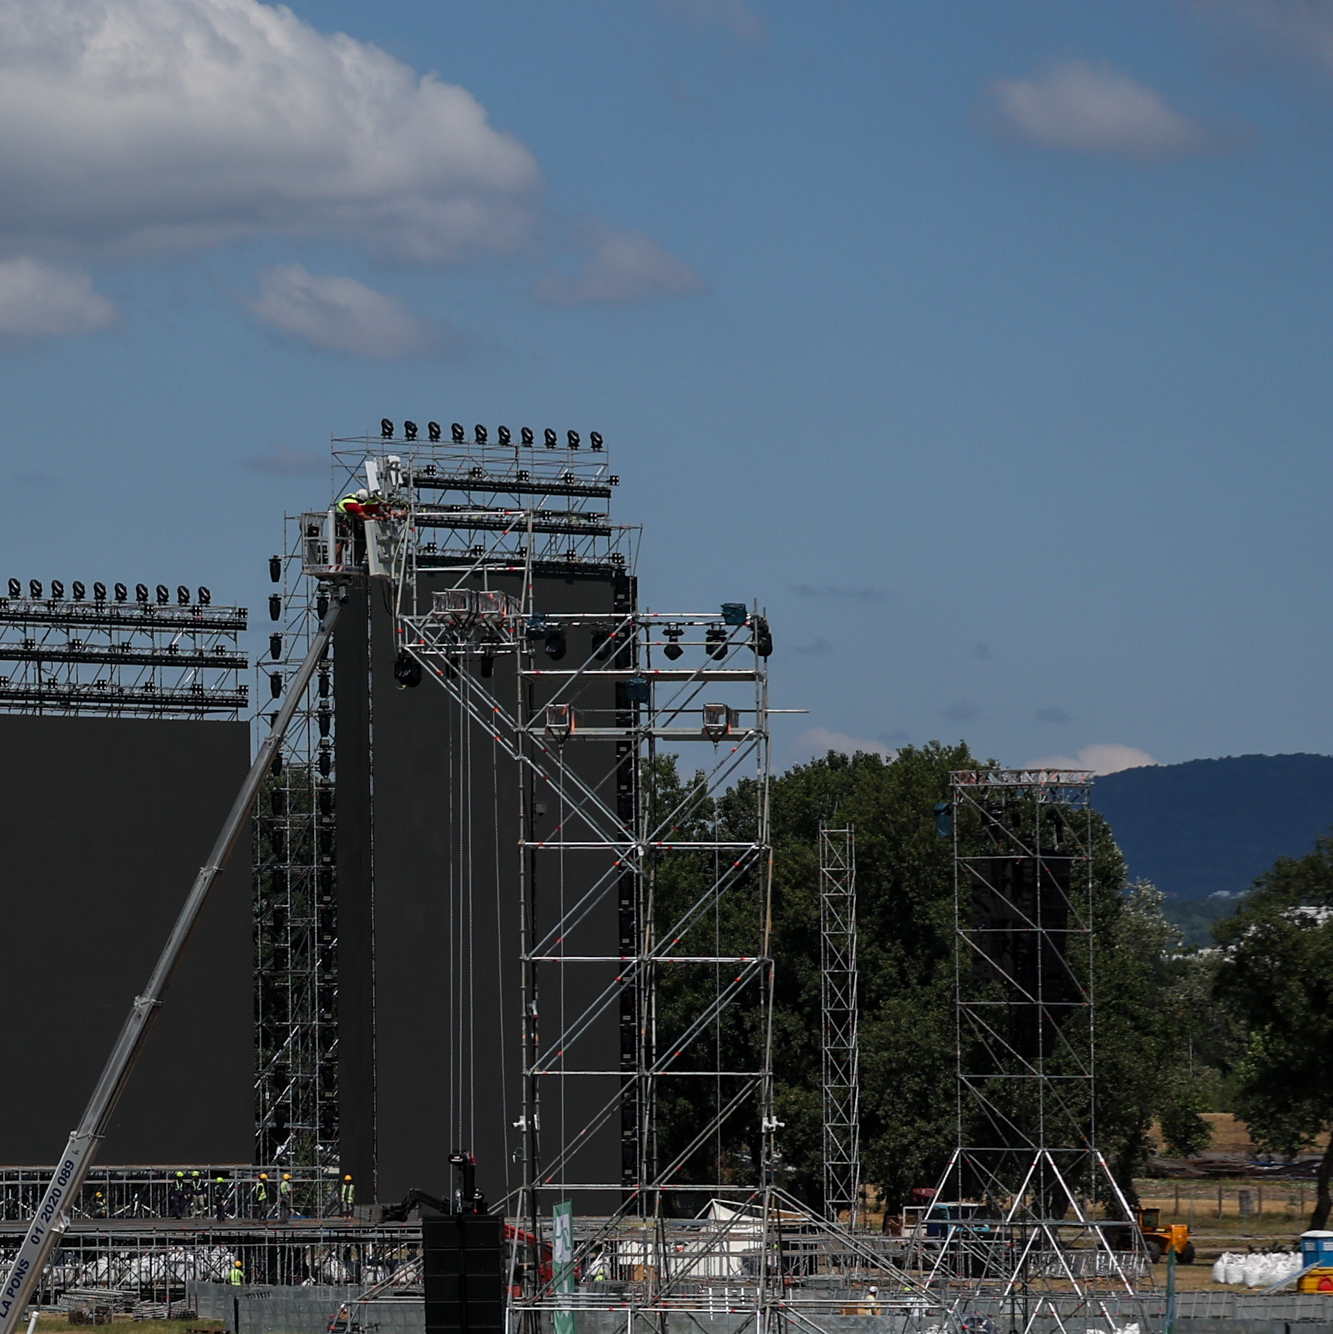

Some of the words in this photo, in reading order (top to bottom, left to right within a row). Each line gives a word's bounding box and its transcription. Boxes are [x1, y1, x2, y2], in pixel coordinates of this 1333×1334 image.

[6, 1258, 30, 1299] PONS
[30, 1187, 62, 1245] 01/2020
[57, 1159, 75, 1188] 089
